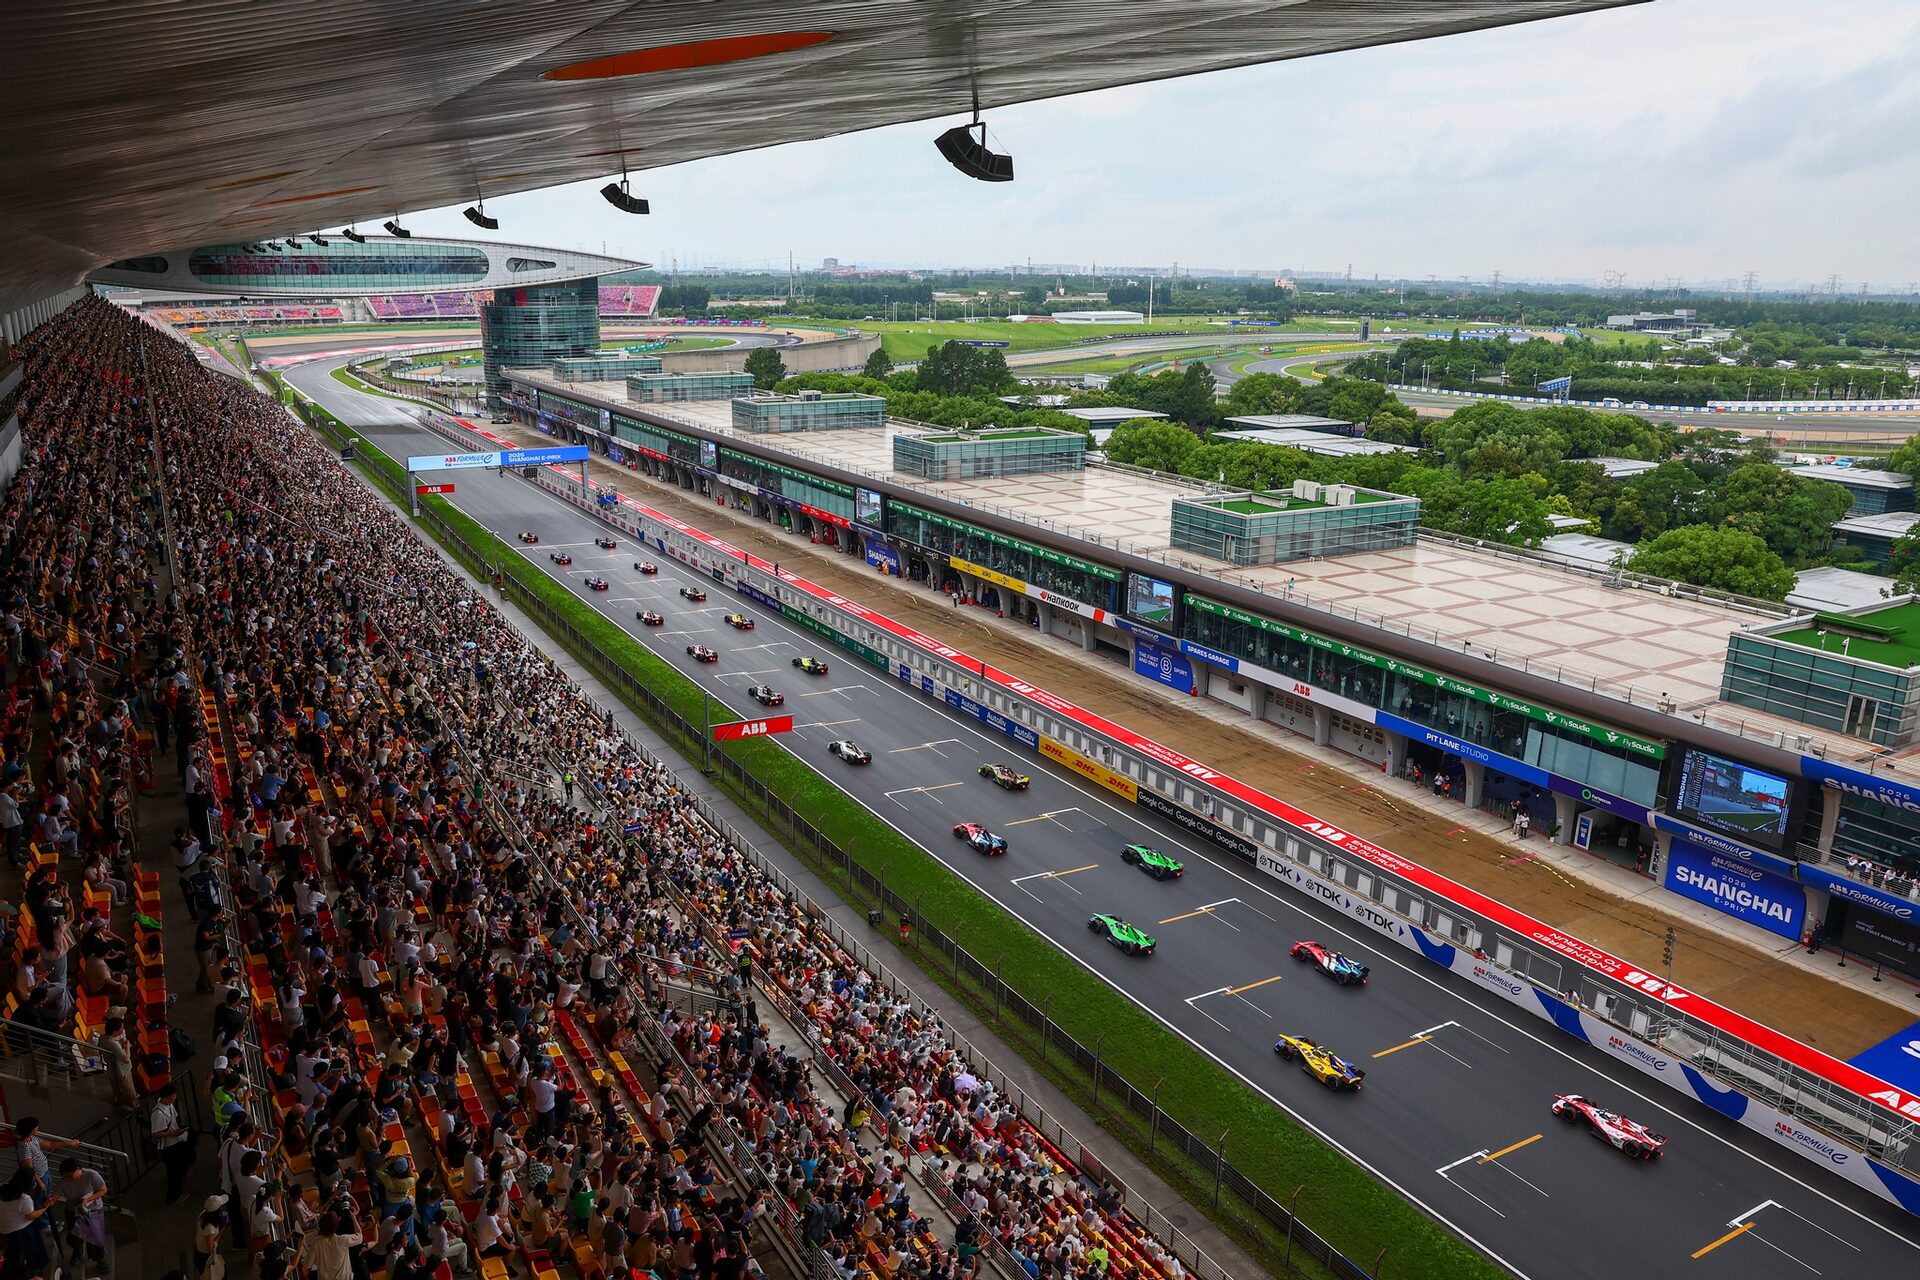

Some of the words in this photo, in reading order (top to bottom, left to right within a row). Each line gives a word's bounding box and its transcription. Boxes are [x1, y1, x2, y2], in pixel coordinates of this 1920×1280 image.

[1187, 646, 1208, 658] SPARES
[1208, 652, 1230, 666] GARAGE
[1293, 683, 1310, 697] ABB
[961, 698, 979, 713] Autoliv
[741, 722, 767, 735] ABB
[986, 712, 1006, 727] Autoliv
[1289, 716, 1295, 725] 5
[1014, 726, 1035, 742] Autoliv
[1045, 743, 1064, 759] DHL
[1426, 733, 1439, 744] PIT
[1439, 737, 1460, 751] LANE
[1460, 745, 1489, 762] STUDIO
[1075, 759, 1096, 775] DHL
[1108, 777, 1130, 794] DHL
[1677, 773, 1687, 810] SHANGHAI
[1880, 787, 1910, 800] 2026
[1139, 792, 1157, 808] Google
[1158, 801, 1174, 815] Cloud
[1176, 811, 1195, 828] Google
[1197, 822, 1213, 836] Cloud
[1216, 831, 1237, 849] Google
[1238, 844, 1256, 859] Cloud
[1301, 822, 1346, 840] ABB
[1688, 831, 1703, 841] ABB
[1703, 836, 1740, 854] FORMULA
[1344, 843, 1358, 851] TO
[1358, 850, 1400, 870] OUTRUN
[1351, 840, 1414, 871] ENGINEERED
[1712, 856, 1724, 864] ABB
[1723, 860, 1751, 876] FORMULA
[1722, 875, 1746, 888] 2026
[1267, 858, 1292, 880] TDK
[1314, 882, 1342, 905] TDK
[1365, 908, 1394, 933] TDK
[1675, 866, 1792, 923] SHANGHAI
[1829, 883, 1848, 894] ABB
[1848, 889, 1896, 911] FORMULA
[1714, 897, 1746, 913] E-PRIX
[1533, 932, 1616, 973] ENGINEERED
[1550, 932, 1603, 959] OUTRUN
[1604, 959, 1622, 969] TO
[1474, 966, 1485, 975] ABB
[1485, 972, 1513, 988] FORMULA
[1624, 971, 1690, 1000] ABB
[1609, 1036, 1623, 1046] ABB
[1623, 1043, 1656, 1064] FORMULA
[1776, 1122, 1792, 1134] ABB
[1792, 1130, 1834, 1155] FORMULA
